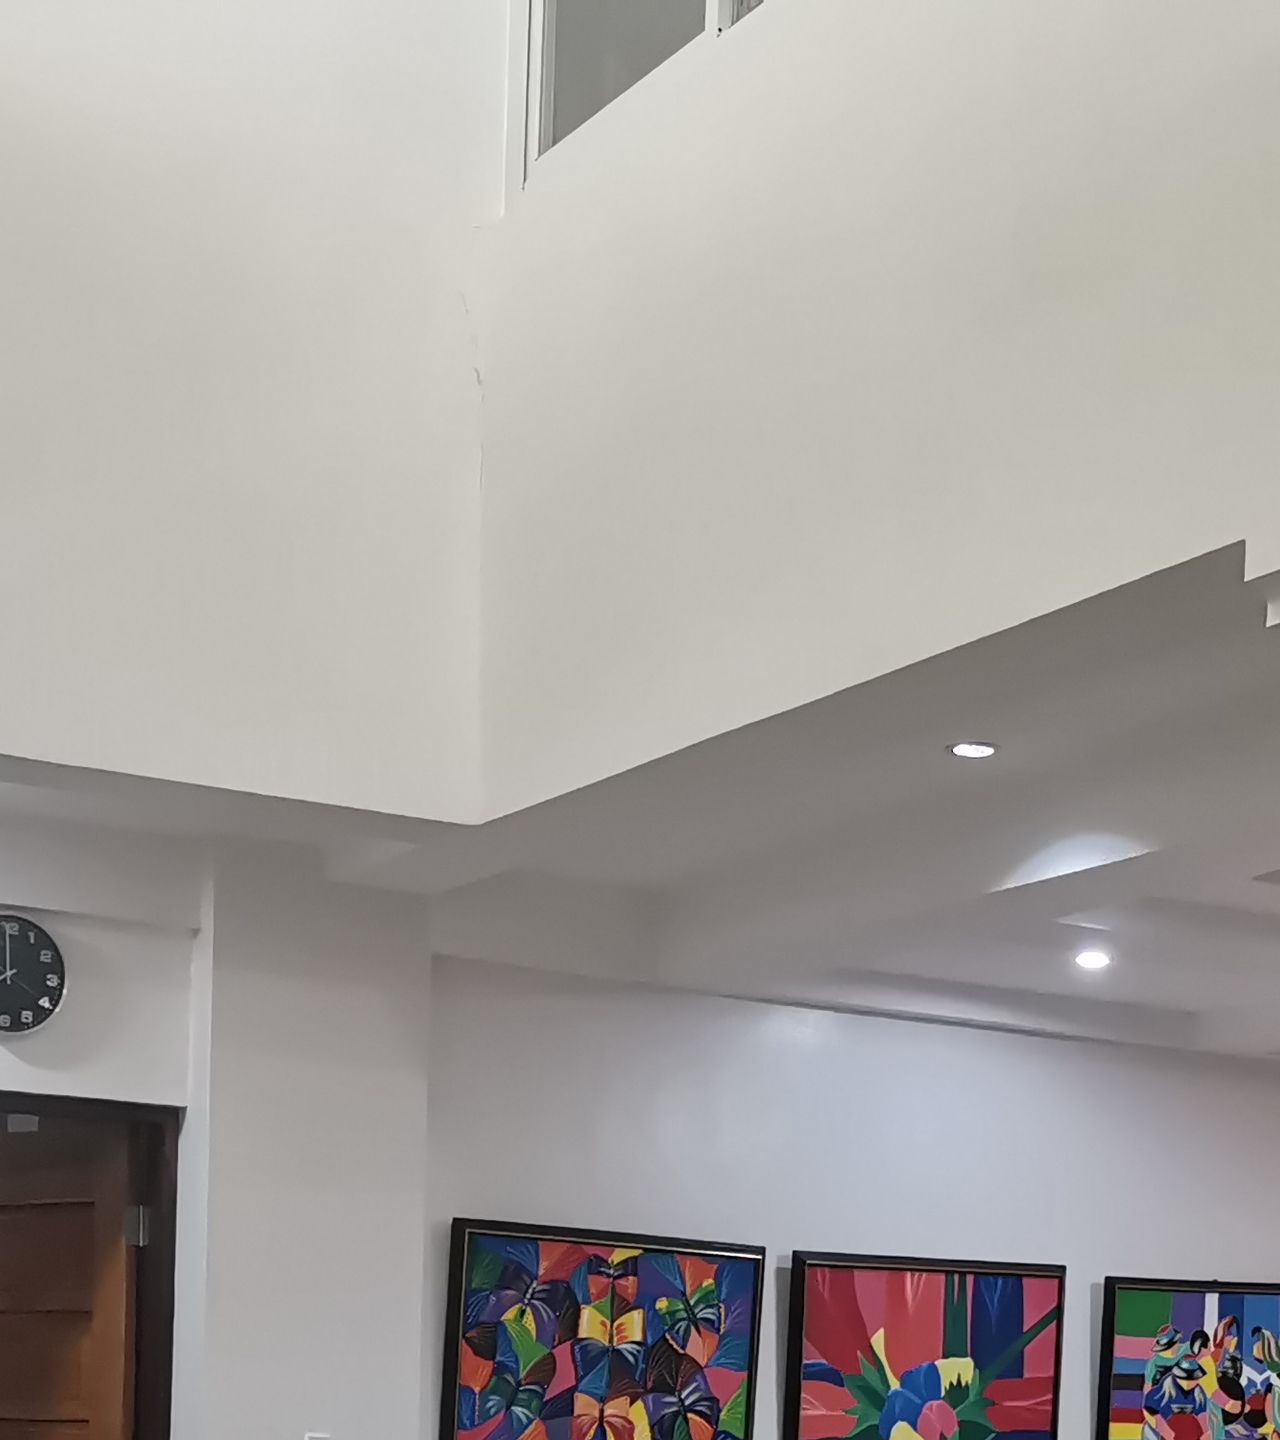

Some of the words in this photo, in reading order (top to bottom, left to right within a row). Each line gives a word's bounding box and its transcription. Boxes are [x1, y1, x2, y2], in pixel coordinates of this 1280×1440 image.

[28, 931, 35, 944] 1
[39, 949, 53, 963] 2
[46, 974, 60, 987] 3
[38, 996, 53, 1009] 4
[20, 1010, 33, 1023] 5
